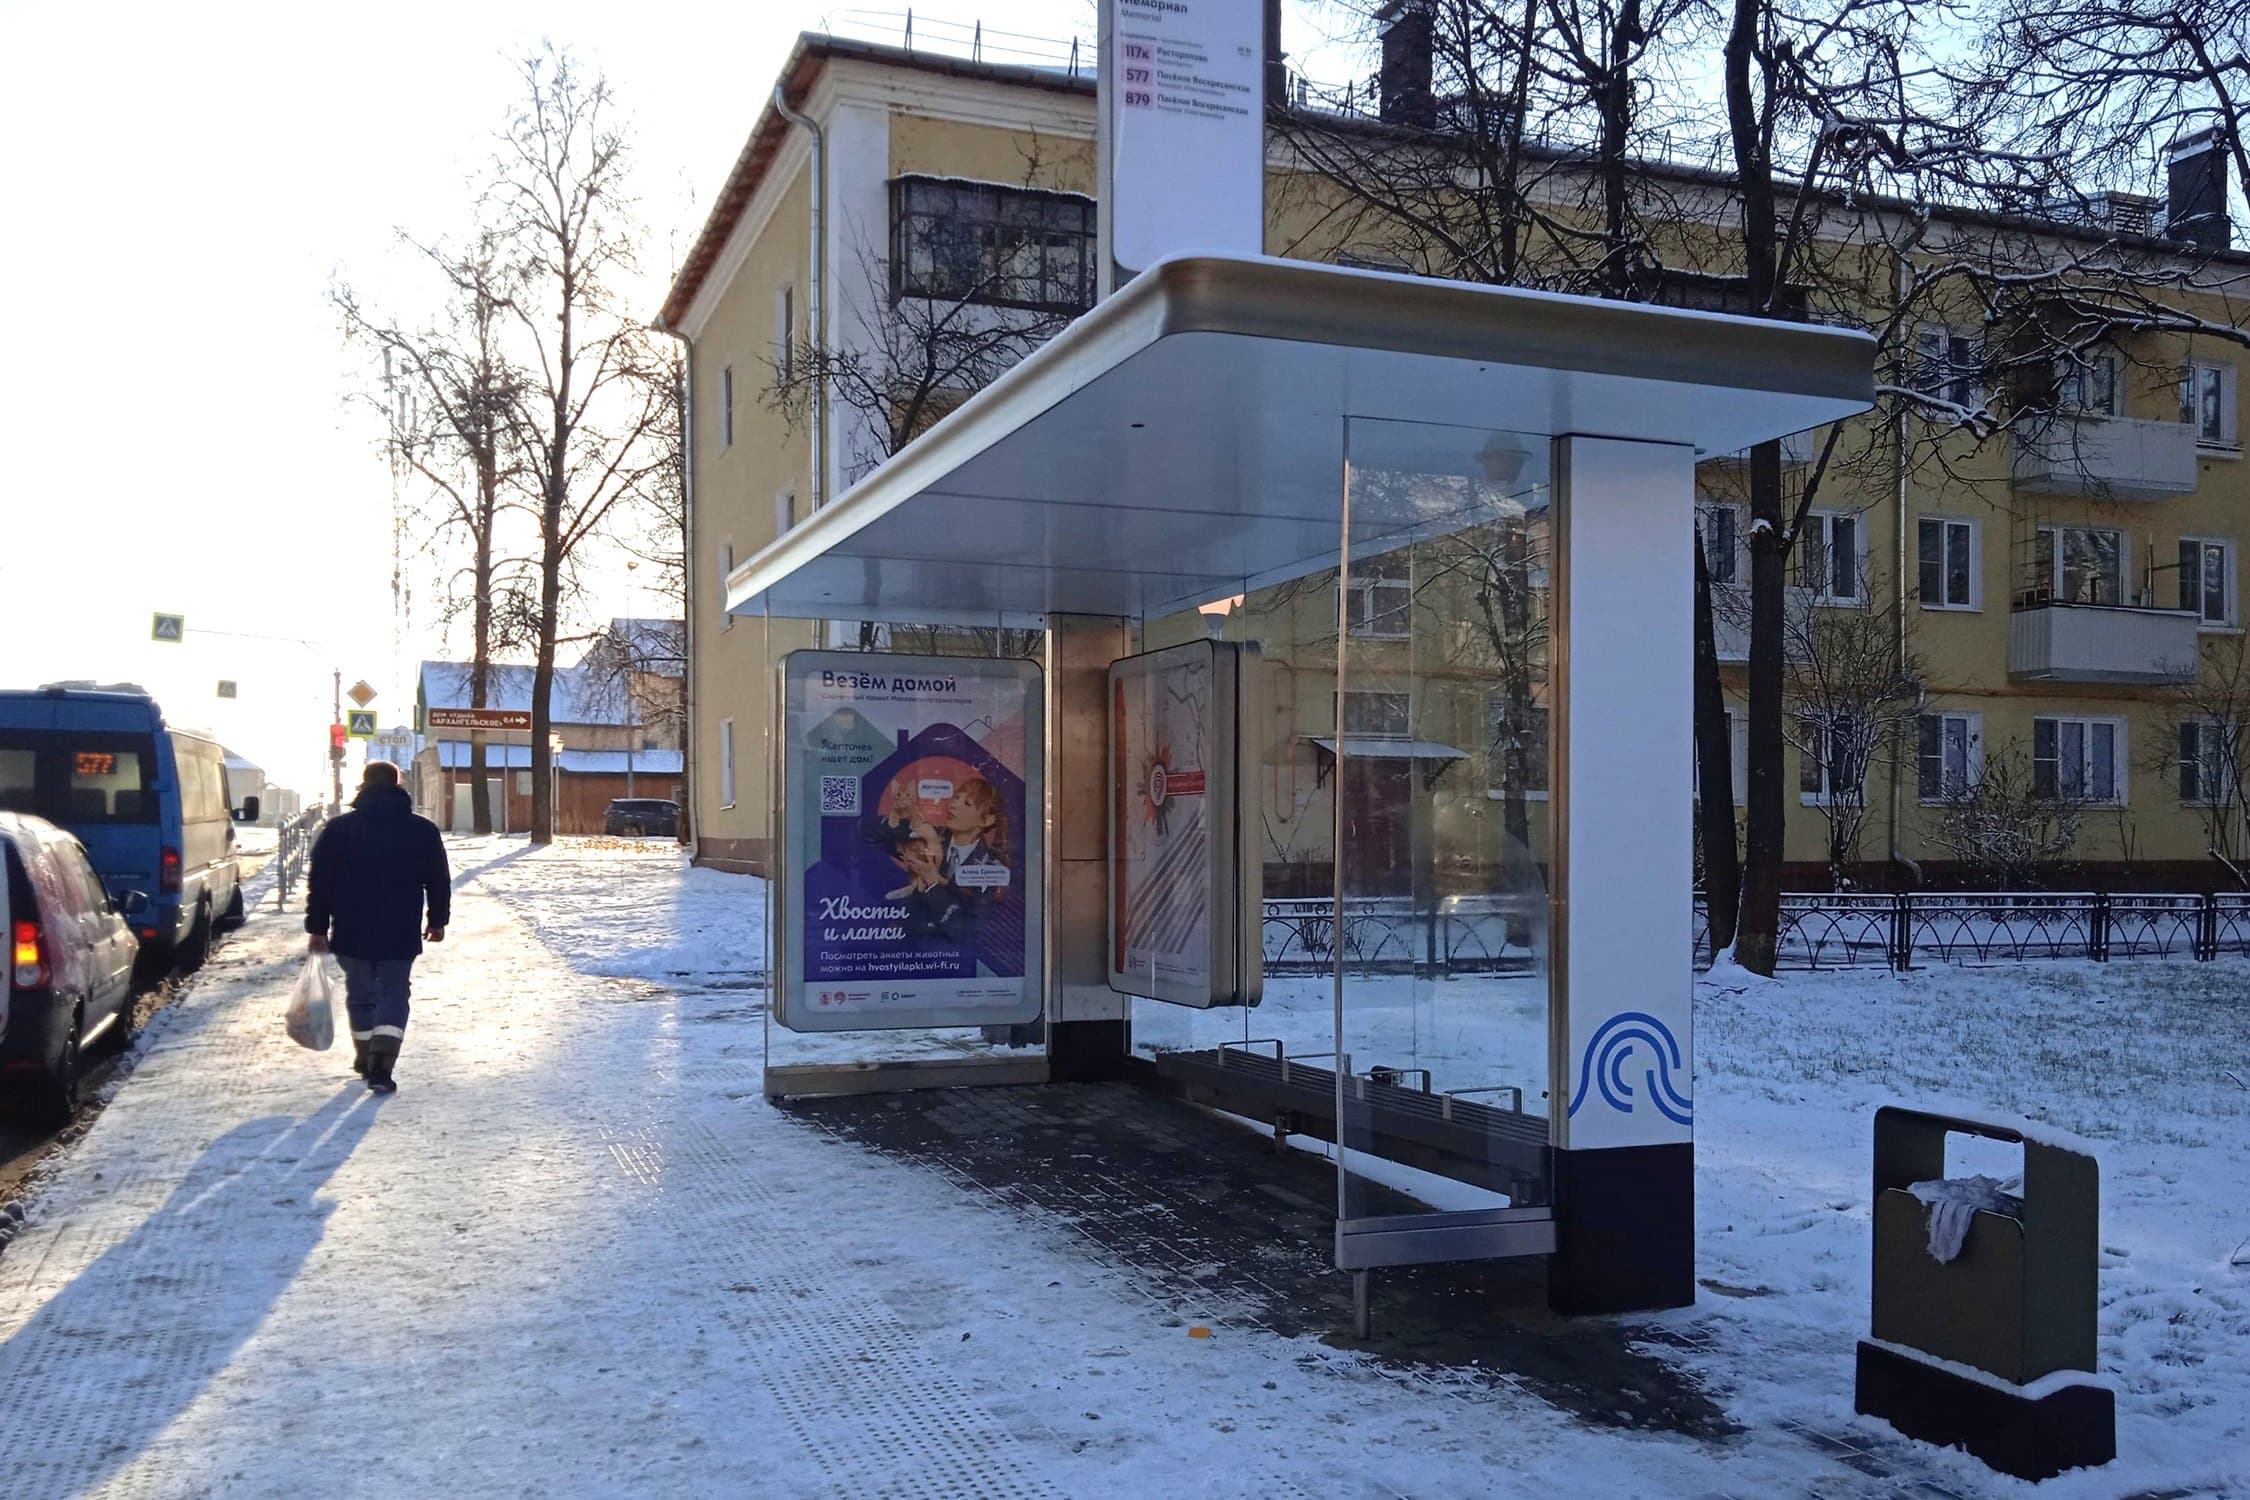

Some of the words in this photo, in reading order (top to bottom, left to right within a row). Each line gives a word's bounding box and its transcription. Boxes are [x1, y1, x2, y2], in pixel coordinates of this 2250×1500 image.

[1126, 45, 1149, 60] 117к
[1126, 68, 1149, 83] 577
[1126, 92, 1150, 106] 879
[823, 670, 886, 690] Везём
[891, 675, 956, 693] домой
[76, 751, 113, 774] 577
[819, 895, 910, 920] Хвосты
[824, 927, 840, 941] и
[841, 927, 907, 940] лапки
[820, 951, 878, 961] Посмотреть
[880, 951, 913, 960] анкеты
[914, 951, 960, 959] животных
[820, 965, 853, 973] можно
[855, 964, 867, 972] на
[868, 961, 960, 973] hvostyilapki.wi-fi.ru
